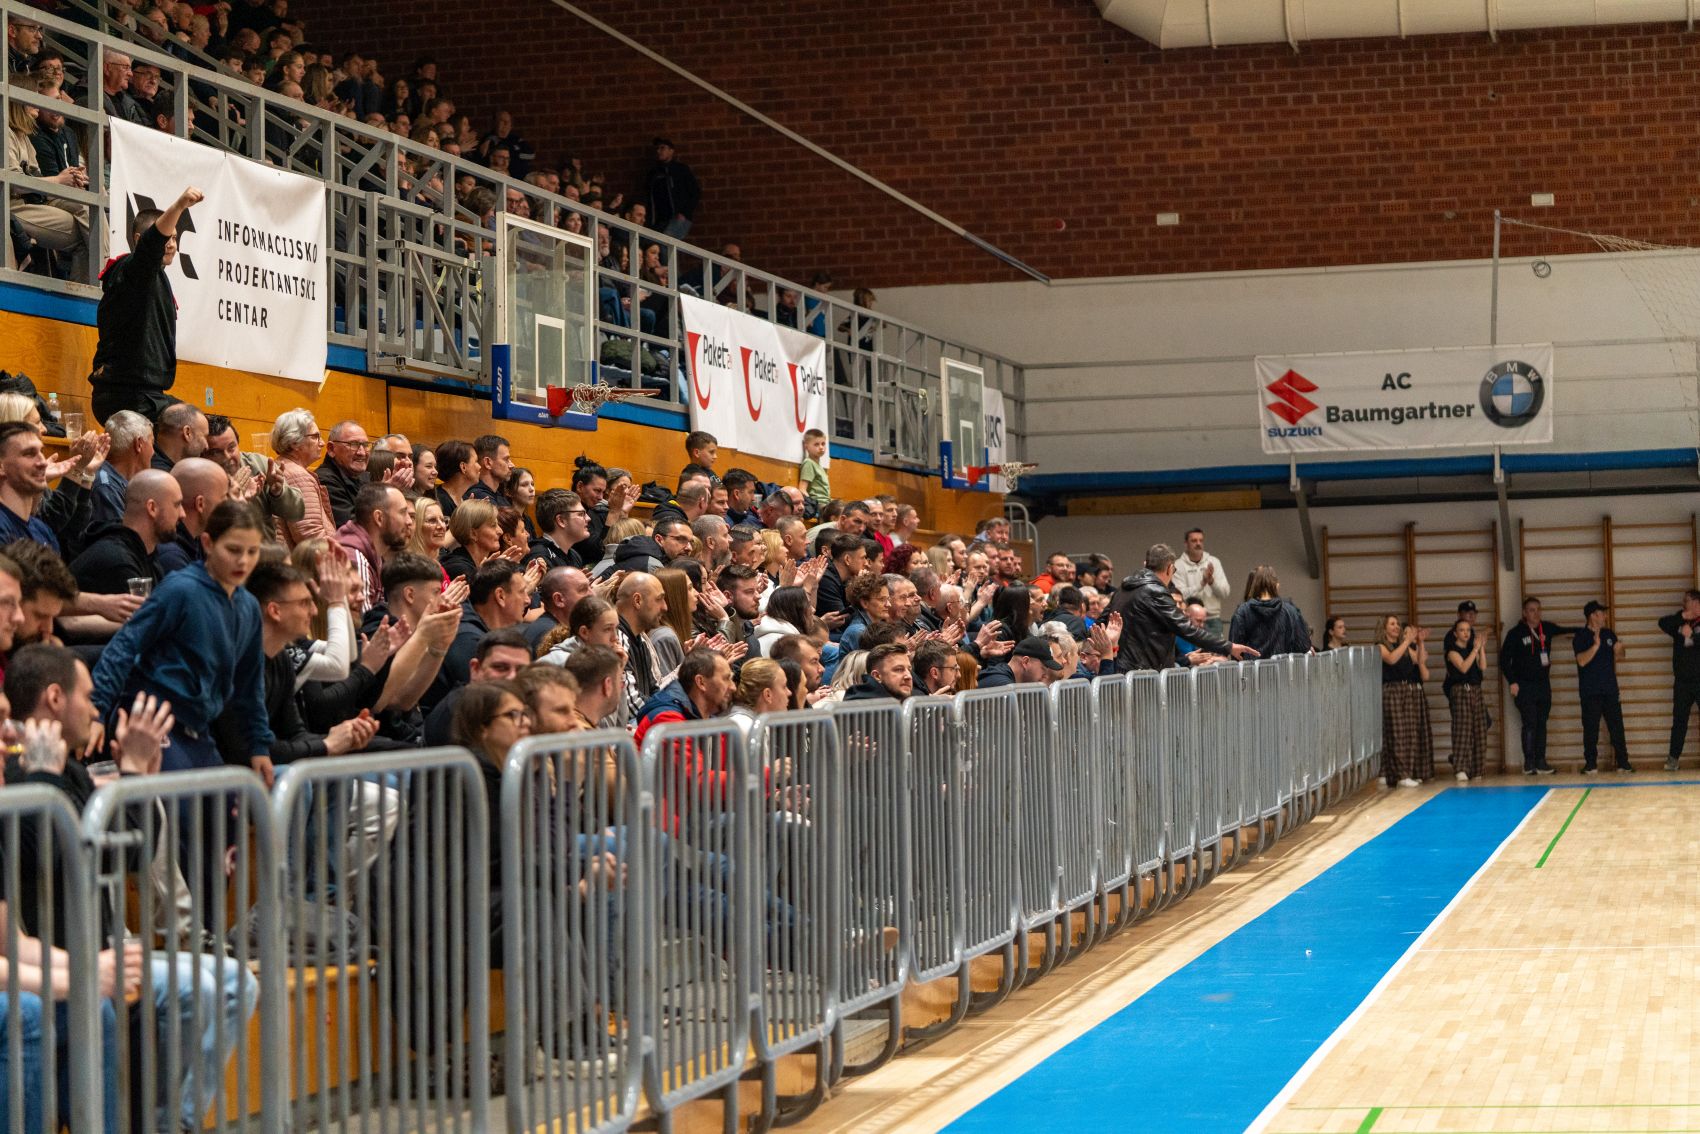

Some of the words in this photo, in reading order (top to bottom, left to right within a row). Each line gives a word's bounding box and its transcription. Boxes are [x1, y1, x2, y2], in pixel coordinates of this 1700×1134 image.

[218, 219, 318, 264] INFORMACIJSKO
[218, 259, 316, 301] PROJEKTANTSKI
[218, 299, 268, 328] CENTAR
[1381, 373, 1412, 390] AC
[1486, 362, 1539, 385] BMW
[1326, 402, 1475, 425] Baumgartner
[1268, 426, 1323, 438] SUZUKI
